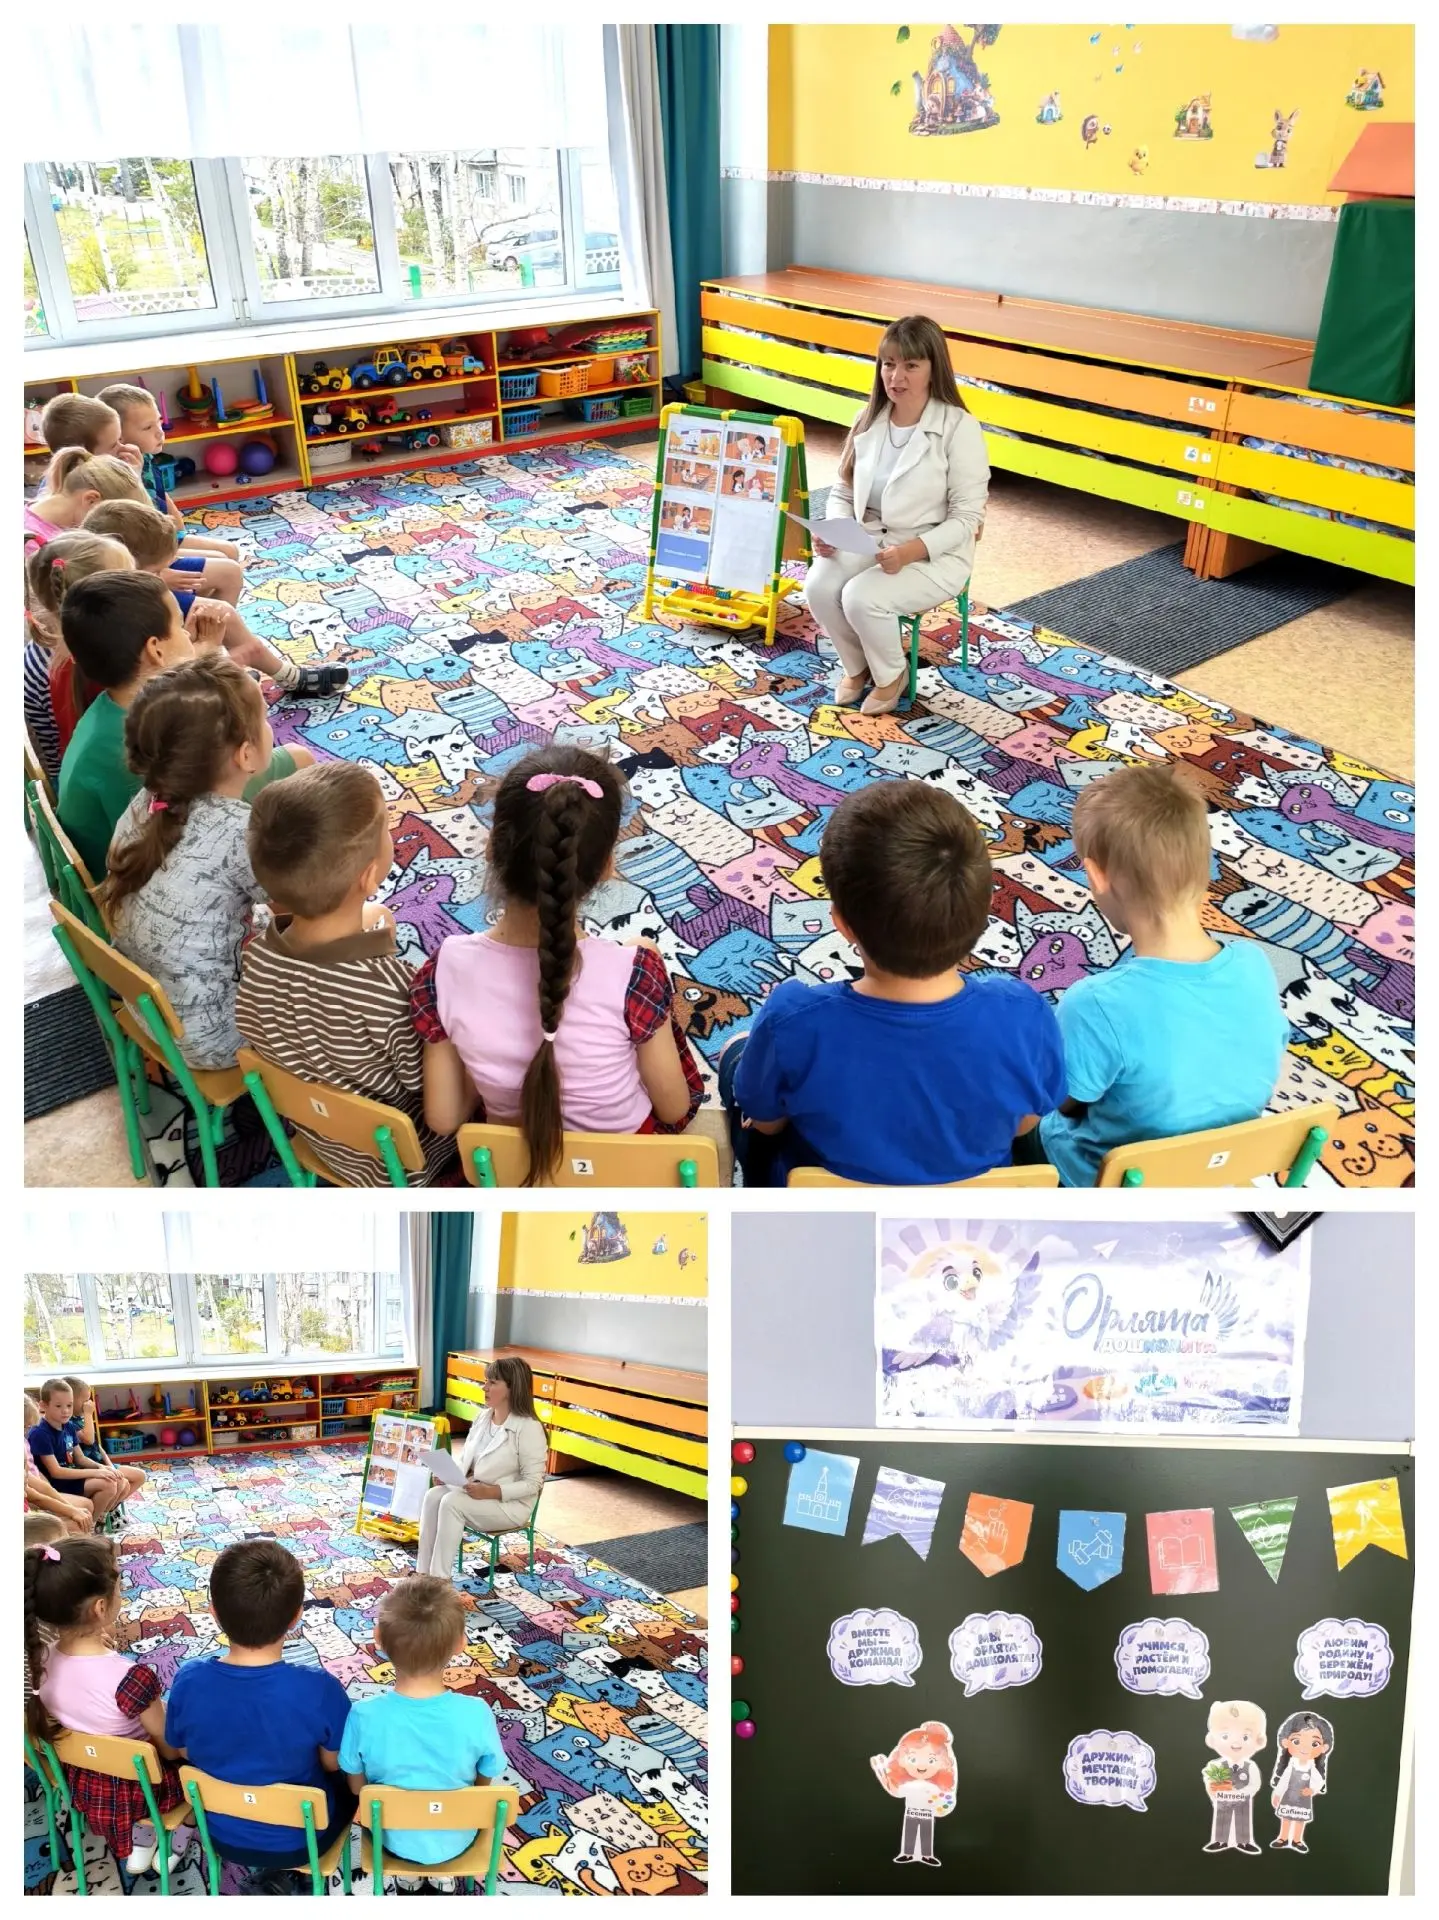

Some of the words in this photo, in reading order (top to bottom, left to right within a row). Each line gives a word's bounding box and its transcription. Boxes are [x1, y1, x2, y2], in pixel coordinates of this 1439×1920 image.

[1213, 1155, 1223, 1164] 2
[578, 1161, 588, 1173] 2
[1062, 1273, 1210, 1351] Орлята
[851, 1629, 891, 1639] ВМЕСТЕ
[978, 1631, 1001, 1644] МЫ
[857, 1638, 877, 1647] МЫ
[1137, 1641, 1189, 1653] УЧИМСЯ,
[1324, 1638, 1369, 1649] ЛЮБИМ
[848, 1647, 901, 1659] ДРУЖНАЯ
[1135, 1651, 1180, 1664] РАСТЁМ
[1182, 1656, 1190, 1665] И
[1318, 1650, 1364, 1659] РОДИНУ
[1366, 1652, 1374, 1660] И
[849, 1657, 903, 1668] КОМАНДА!
[965, 1654, 1035, 1672] ДОШКОЛЯТА!
[1319, 1659, 1373, 1671] БЕРЕЖЁМ
[1132, 1665, 1194, 1676] ПОМОГАЕМ!
[1319, 1670, 1373, 1681] ПРИРОДУ!
[1081, 1752, 1136, 1766] ДРУЖИМ,
[1081, 1764, 1139, 1779] МЕЧТАЕМ,
[1084, 1776, 1138, 1789] ТВОРИМ!
[1217, 1792, 1245, 1800] Матвей
